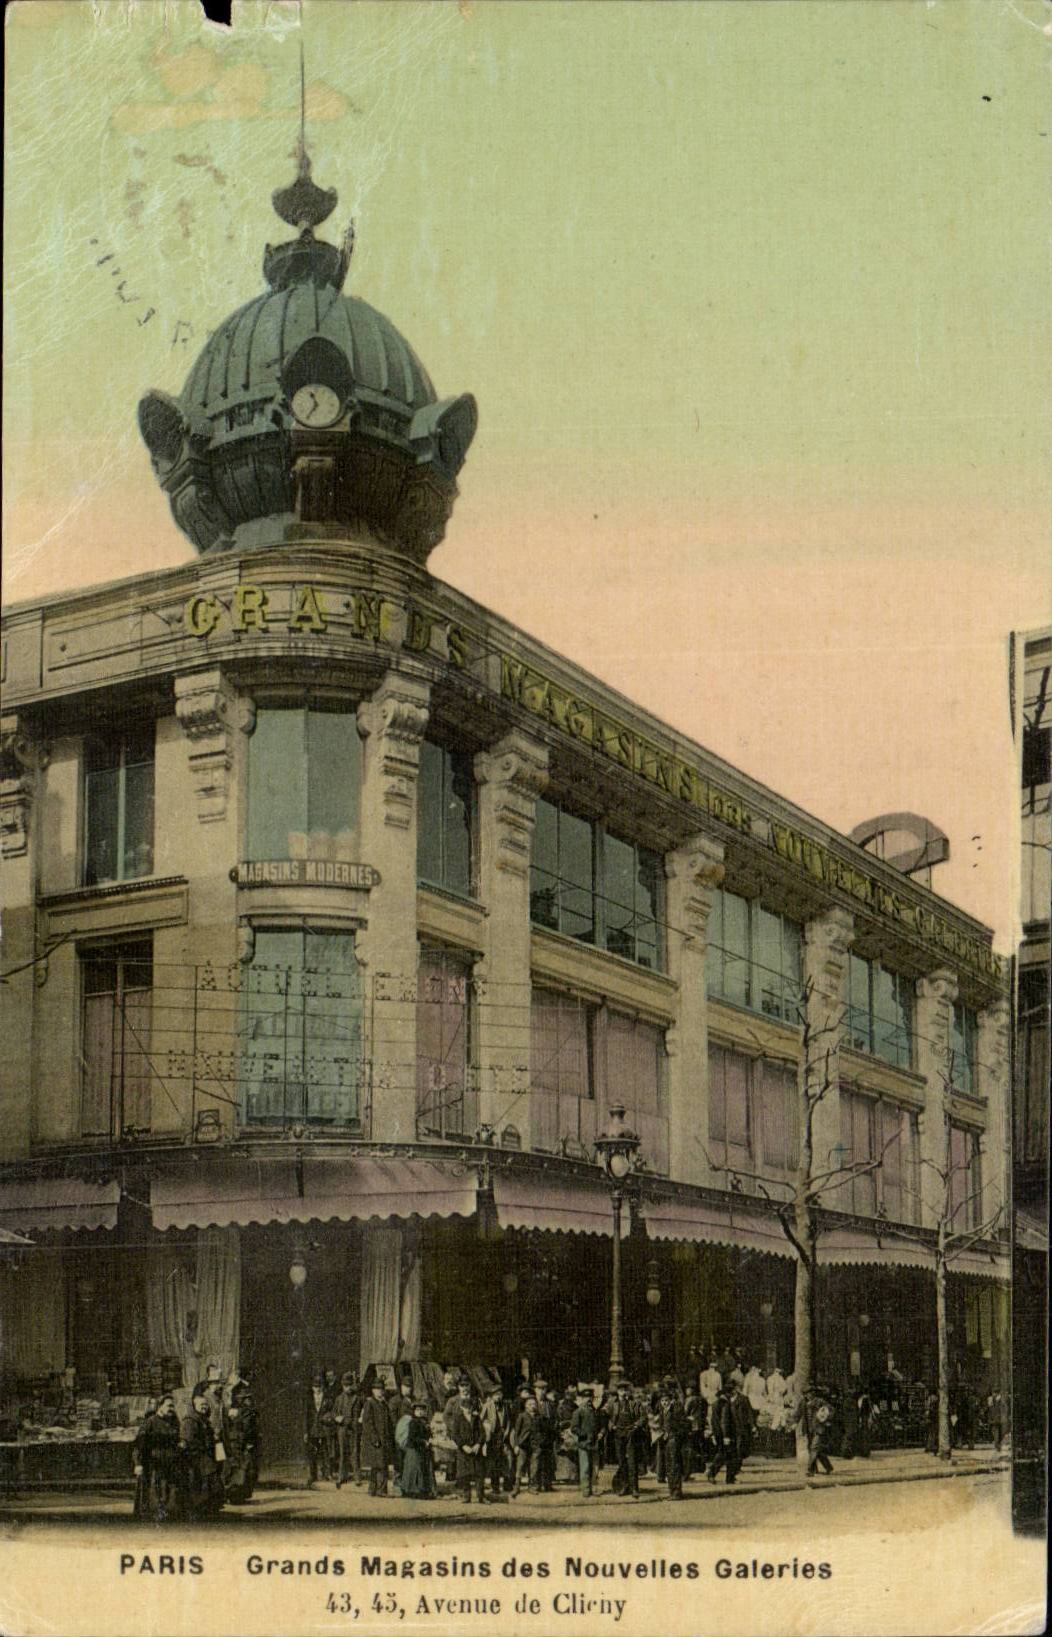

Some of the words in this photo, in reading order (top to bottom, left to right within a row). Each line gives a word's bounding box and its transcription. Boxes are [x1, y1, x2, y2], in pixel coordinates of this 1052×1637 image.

[183, 585, 469, 668] GRANDS
[502, 653, 695, 805] MAGASINS
[237, 861, 299, 883] MAGASINS
[305, 861, 372, 886] MODERNES
